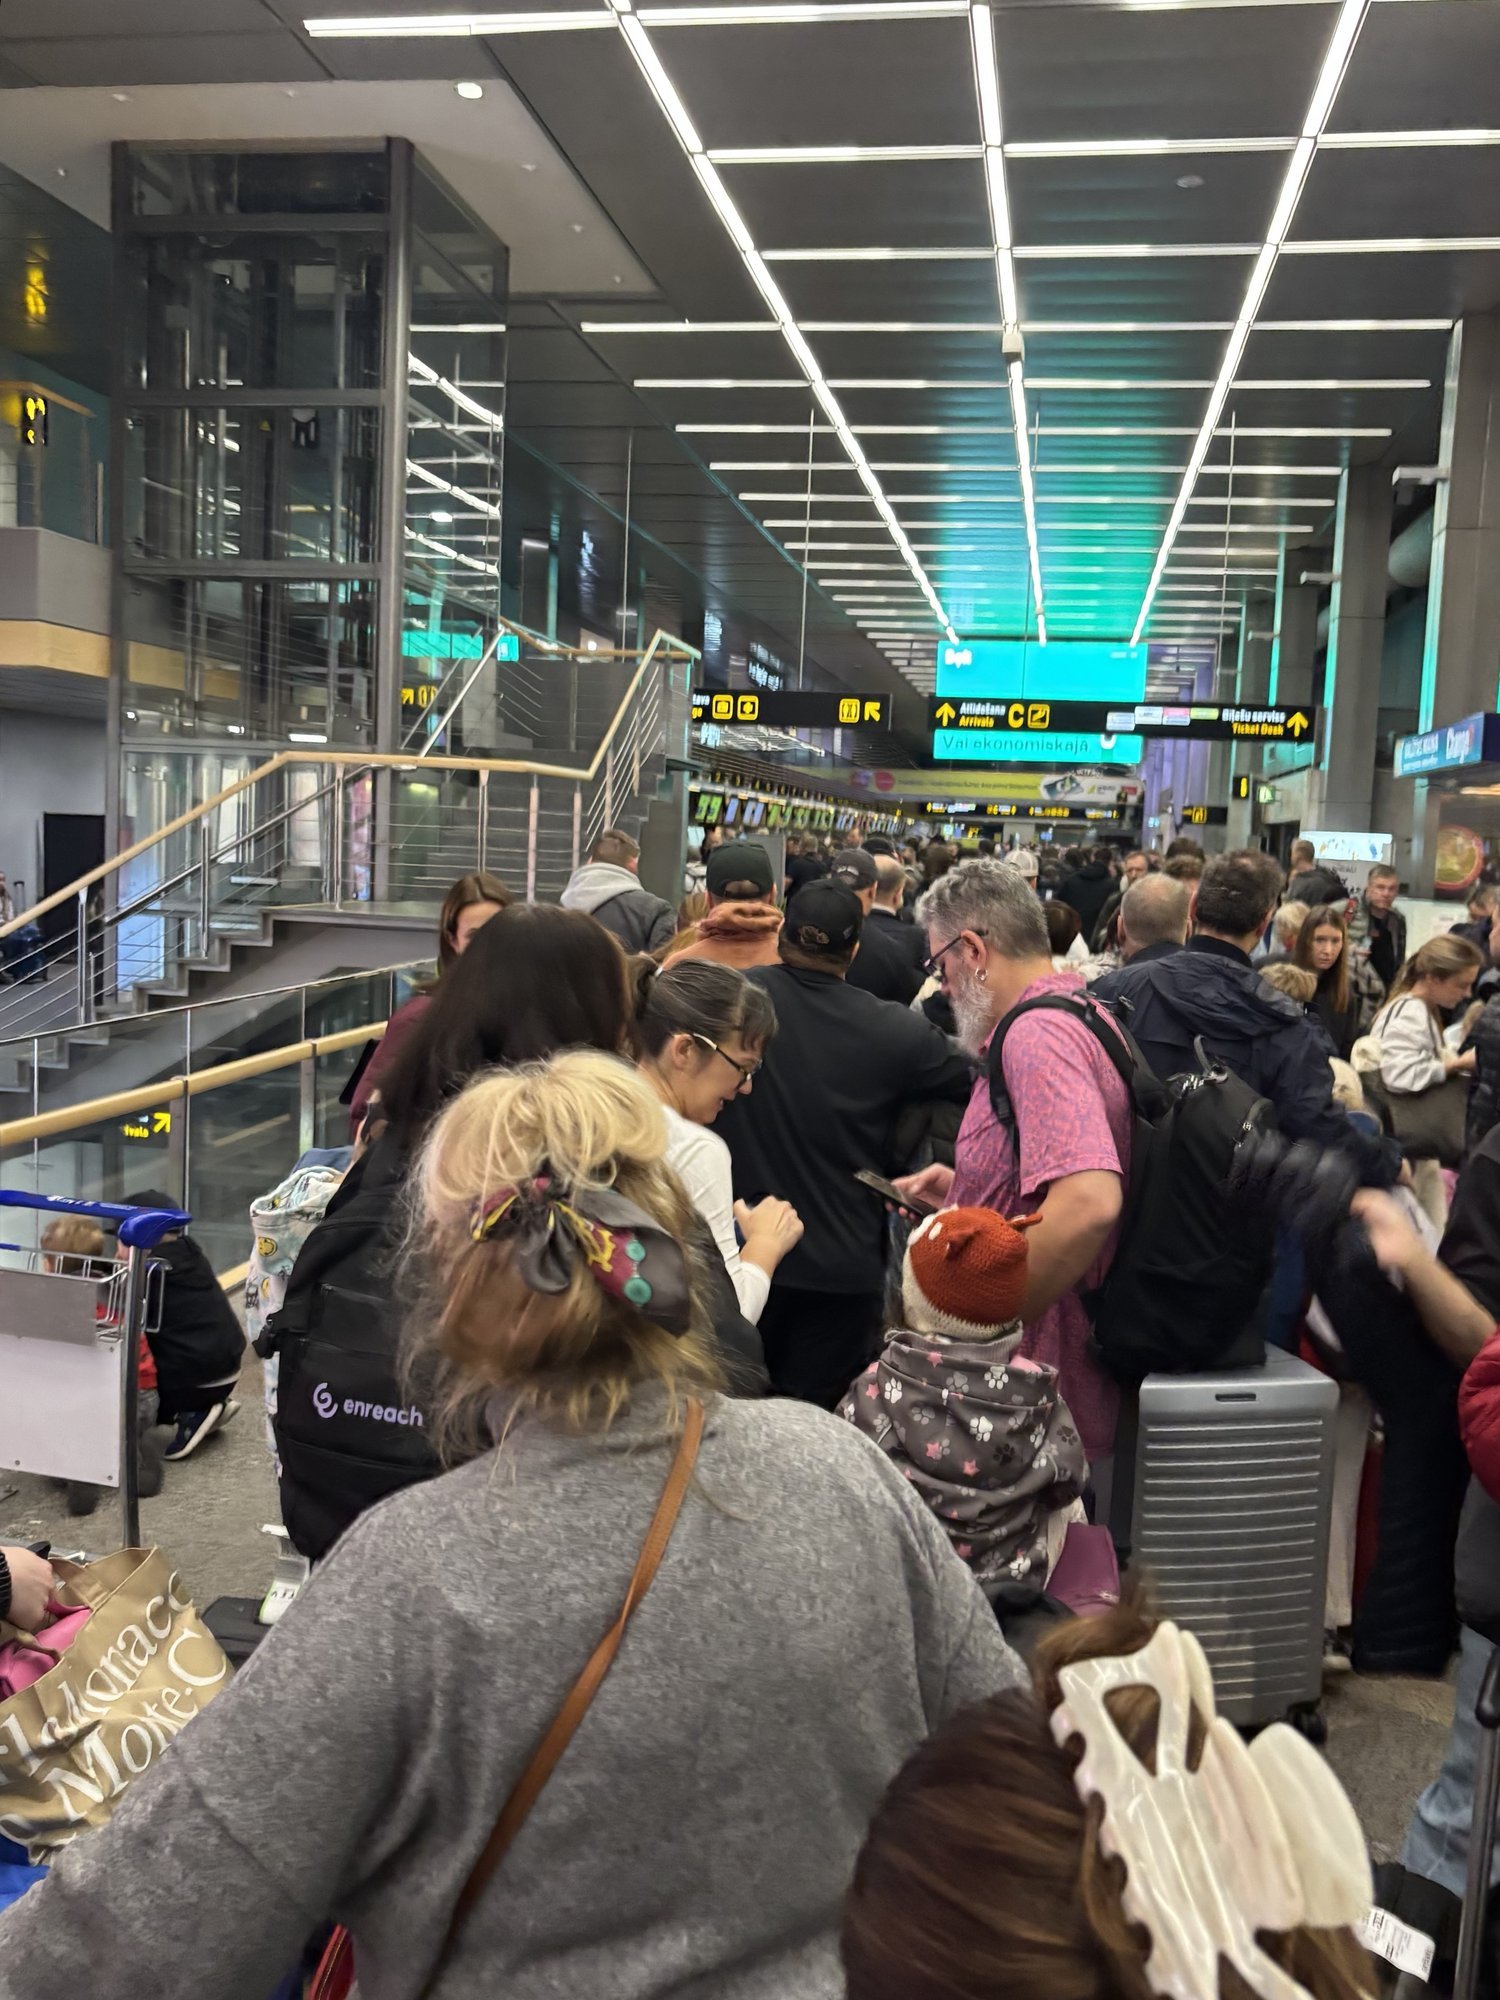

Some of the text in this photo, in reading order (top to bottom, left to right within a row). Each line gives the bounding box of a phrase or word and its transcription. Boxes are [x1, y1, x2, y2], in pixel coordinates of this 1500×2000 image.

[958, 715, 995, 728] Arrivals
[1007, 703, 1025, 729] C
[1232, 722, 1259, 735] Ticket
[343, 1398, 423, 1427] enreach
